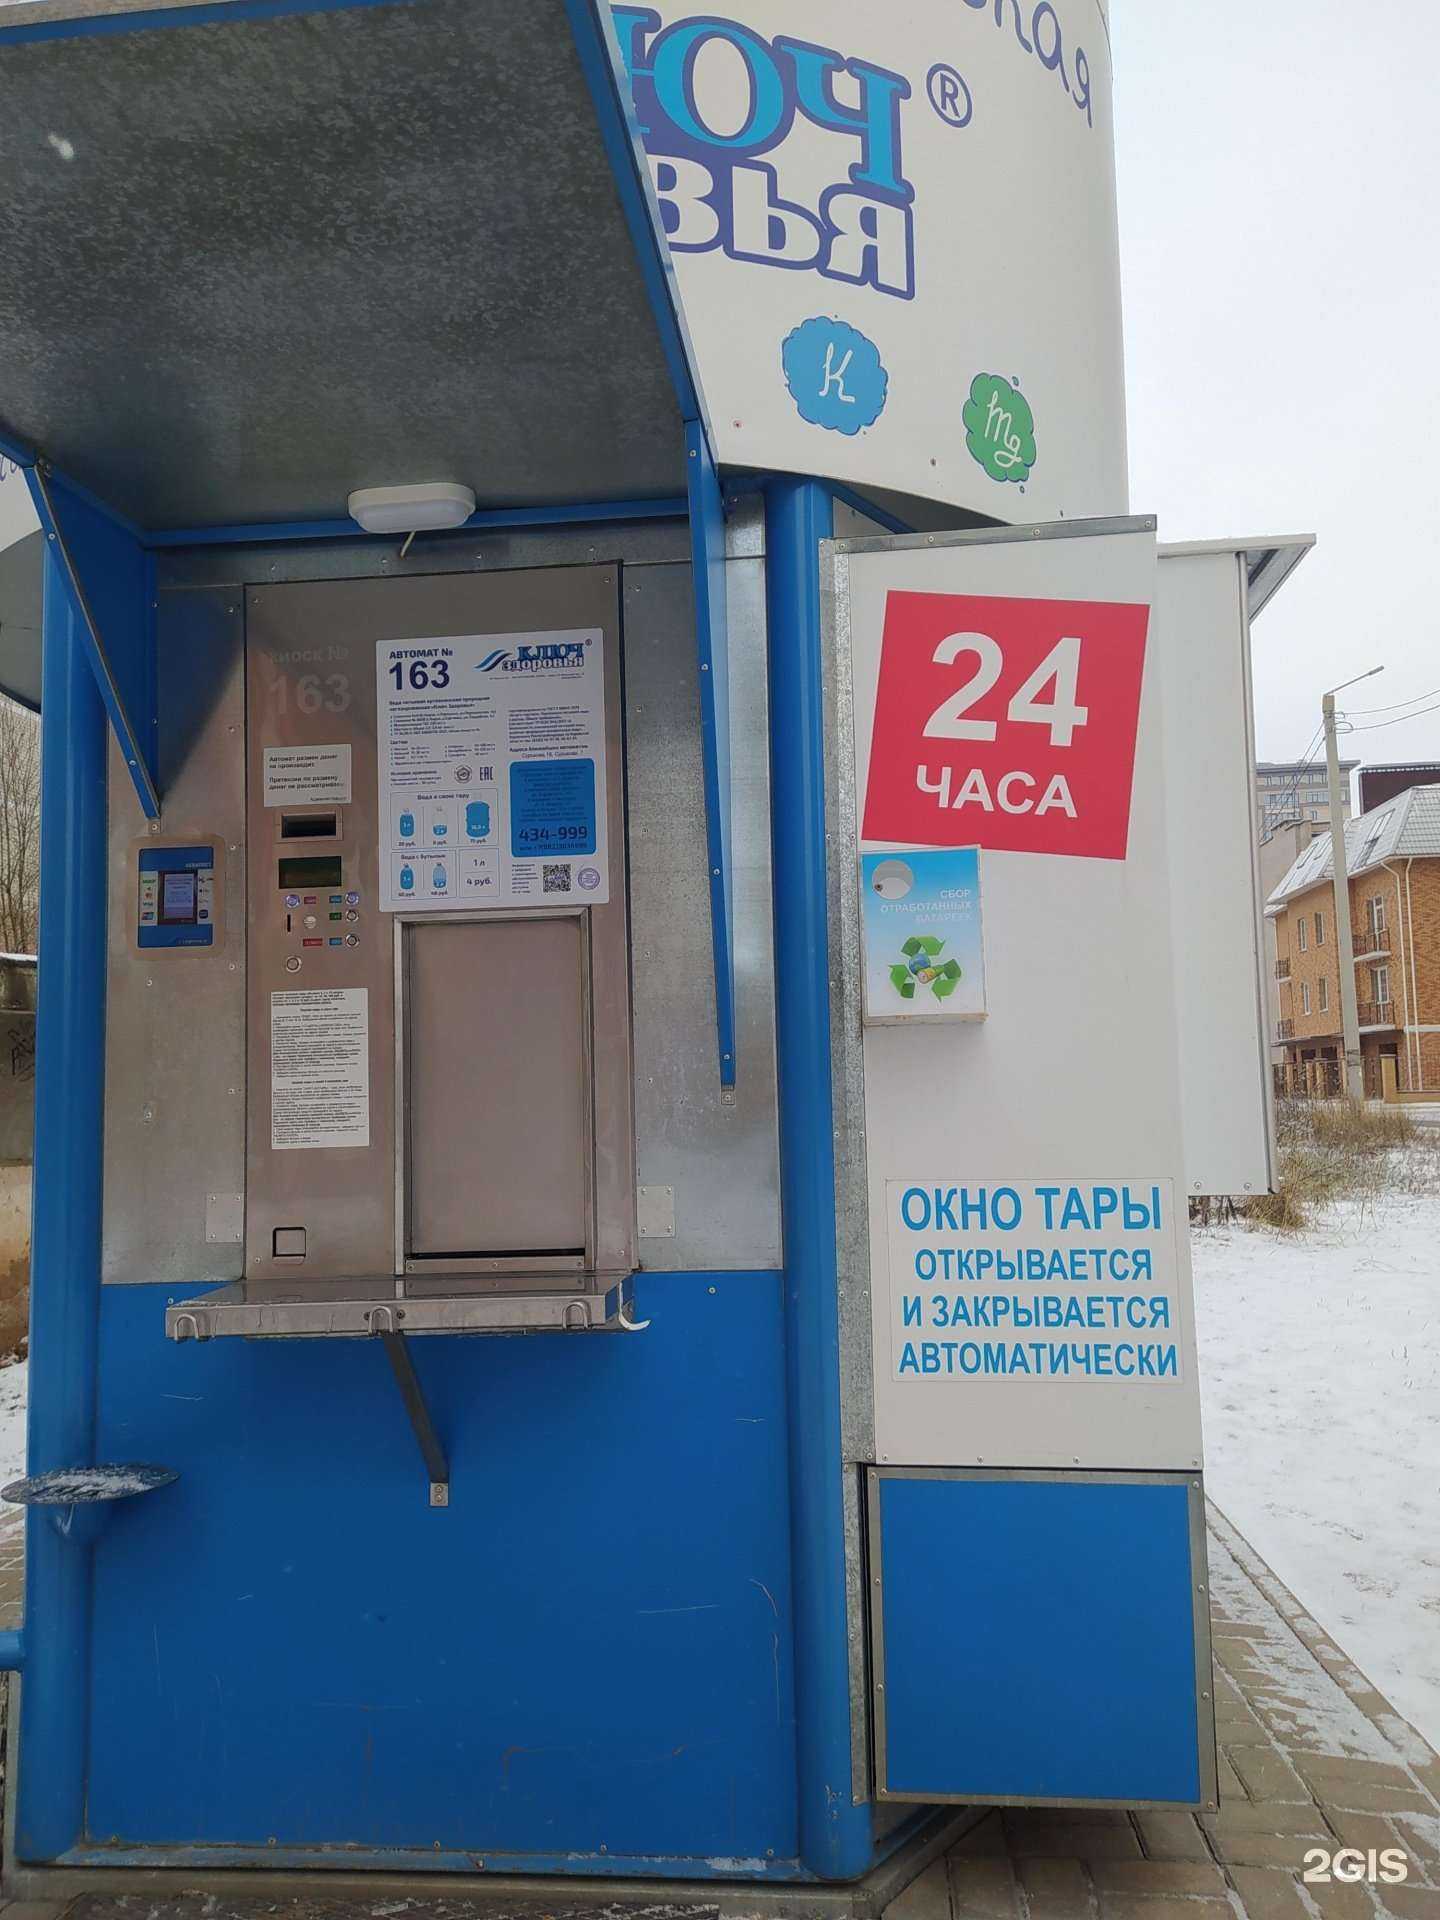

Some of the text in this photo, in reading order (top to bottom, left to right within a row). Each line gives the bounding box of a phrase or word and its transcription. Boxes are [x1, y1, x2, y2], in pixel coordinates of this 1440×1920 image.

[389, 649, 439, 659] АВТОМАТ
[518, 643, 584, 661] КЛЮЧ
[389, 659, 450, 691] 163
[922, 631, 1089, 748] 24
[269, 673, 352, 714] 163
[915, 765, 1078, 818] ЧАСА
[519, 826, 588, 842] 434-999
[474, 877, 493, 887] руб.
[940, 889, 971, 899] СБОР
[901, 1186, 1162, 1231] ОКНО ТАРЫ
[914, 1248, 1152, 1281] ОТКРЫВАЕТСЯ
[903, 1295, 1170, 1329] И ЗАКРЫВАЕТСЯ
[899, 1342, 1179, 1377] АВТОМАТИЧЕСКИ
